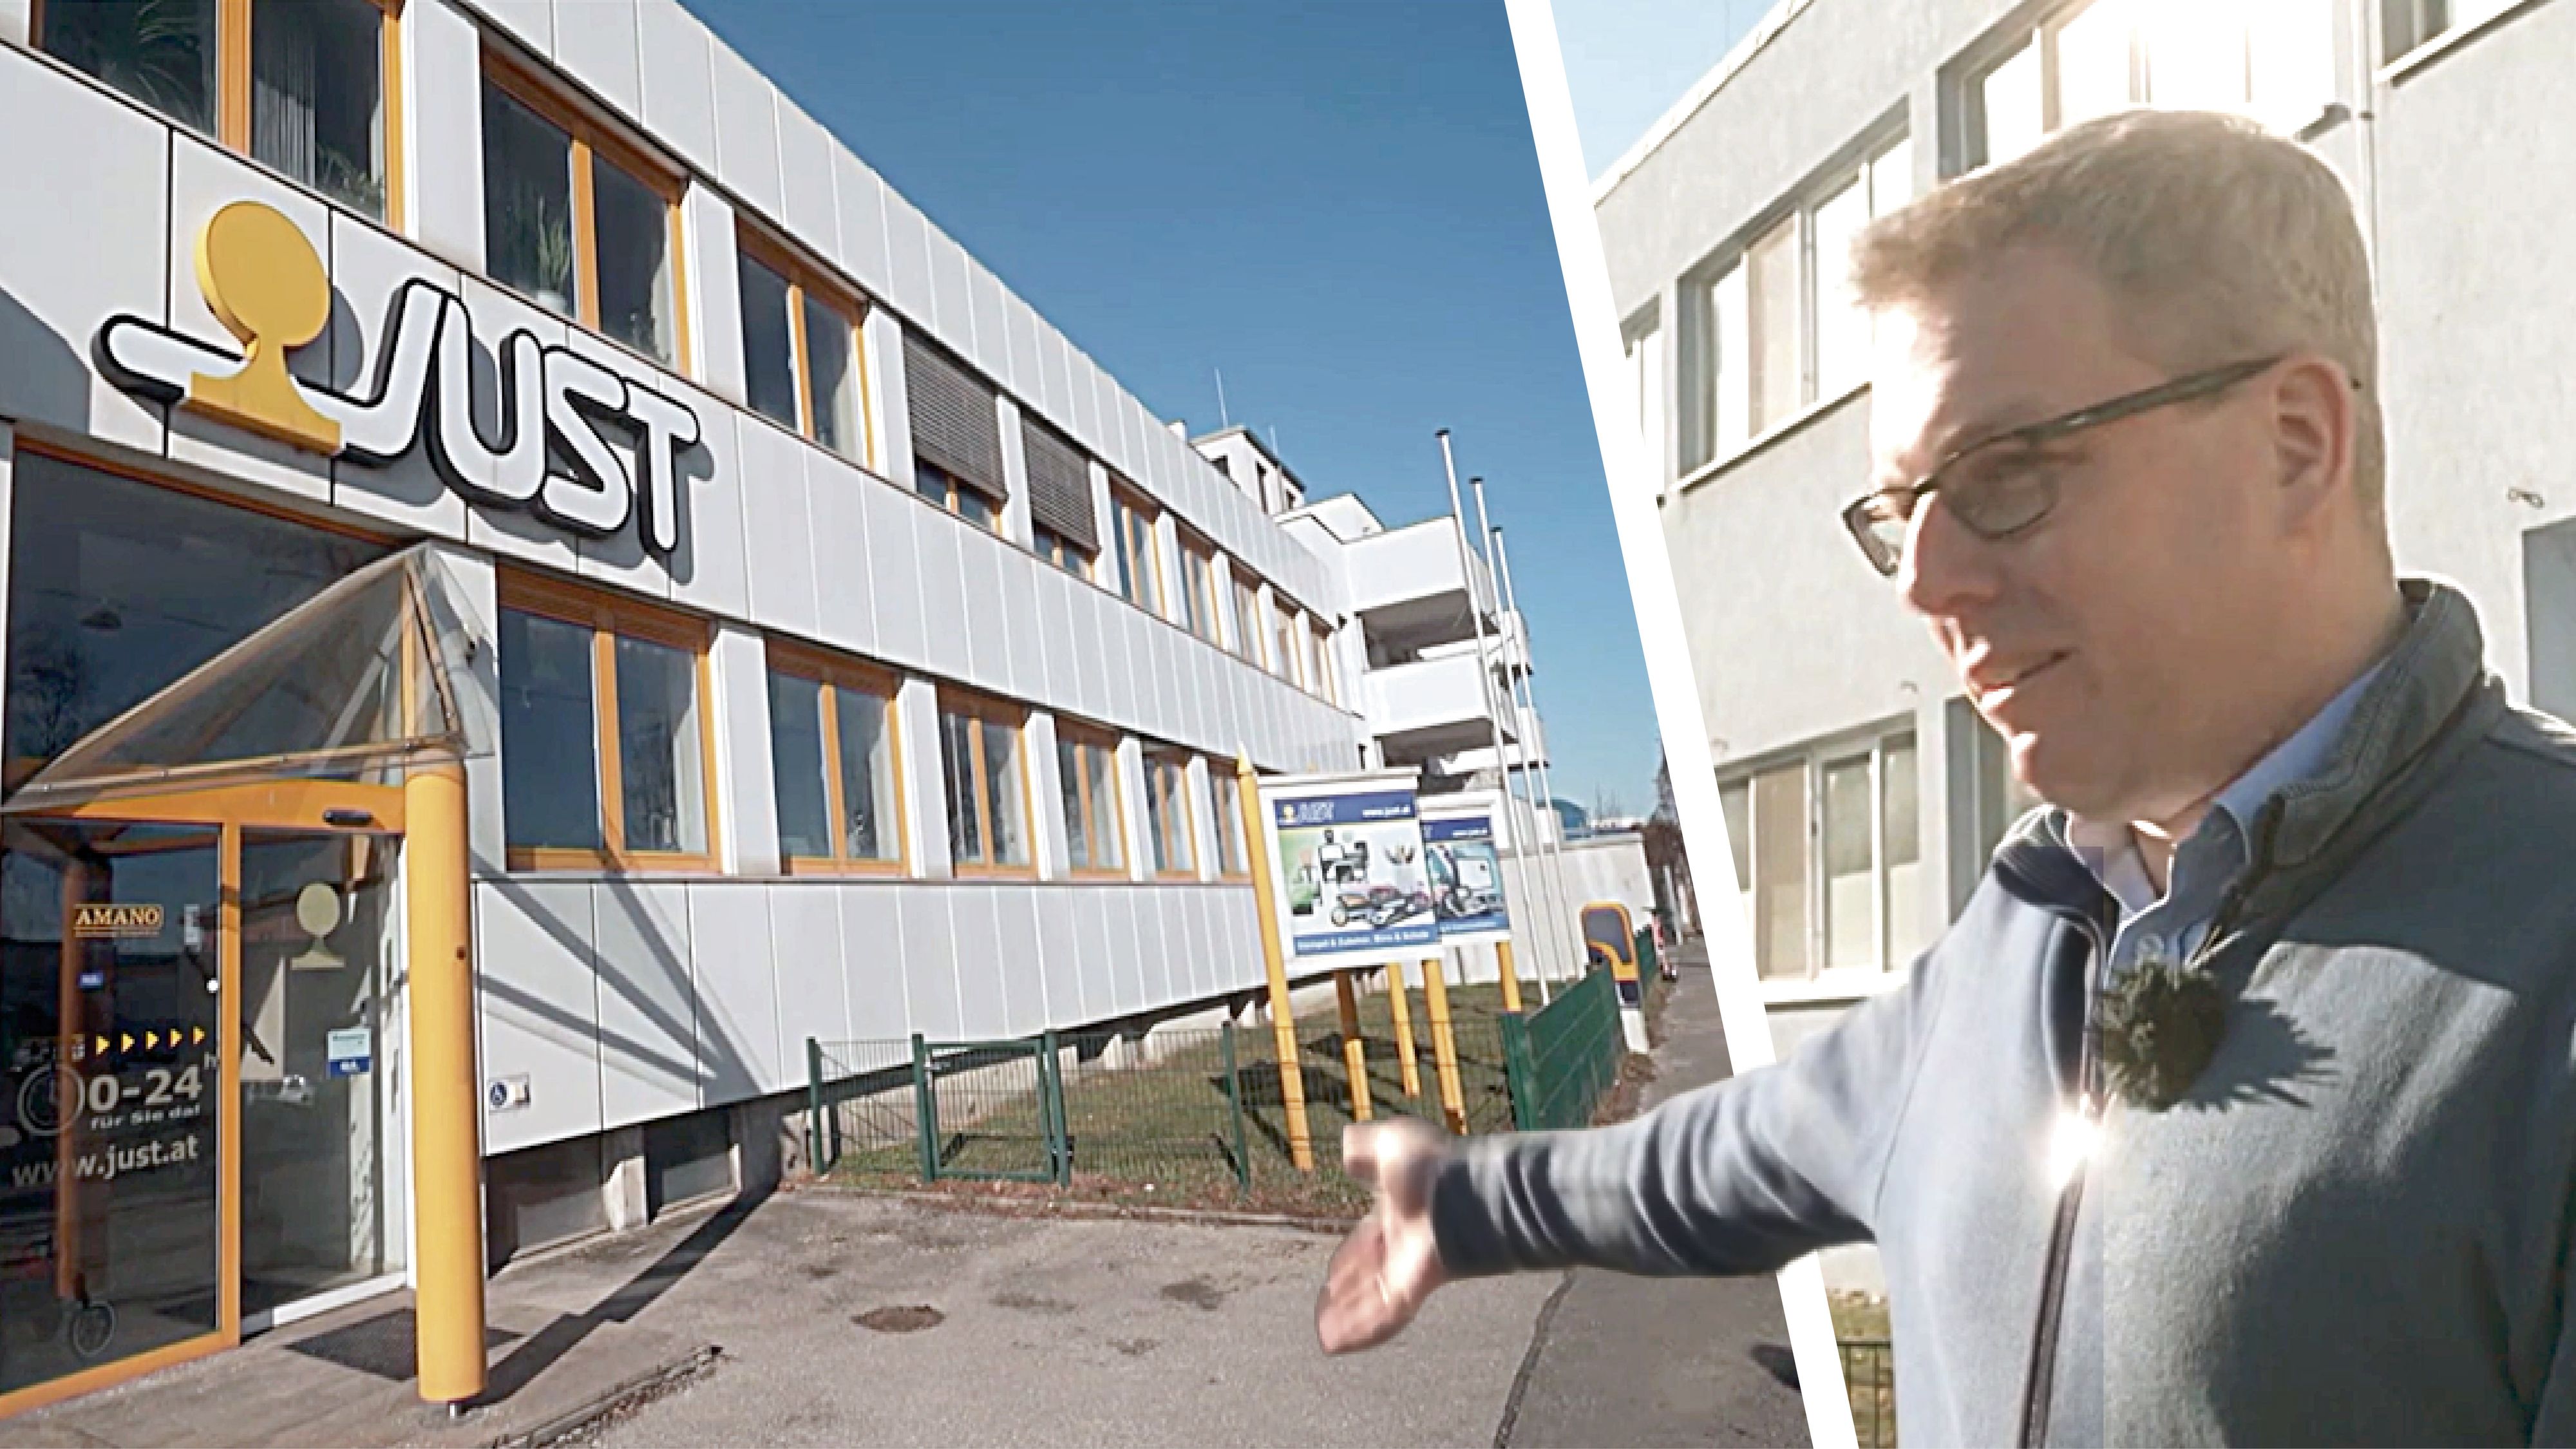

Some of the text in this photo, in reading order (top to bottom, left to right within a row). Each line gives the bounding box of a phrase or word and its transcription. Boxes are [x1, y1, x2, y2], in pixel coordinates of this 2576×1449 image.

[97, 277, 702, 554] JUST
[76, 907, 160, 925] AMANO
[129, 1110, 165, 1126] Sie
[12, 1133, 200, 1188] www.just.at
